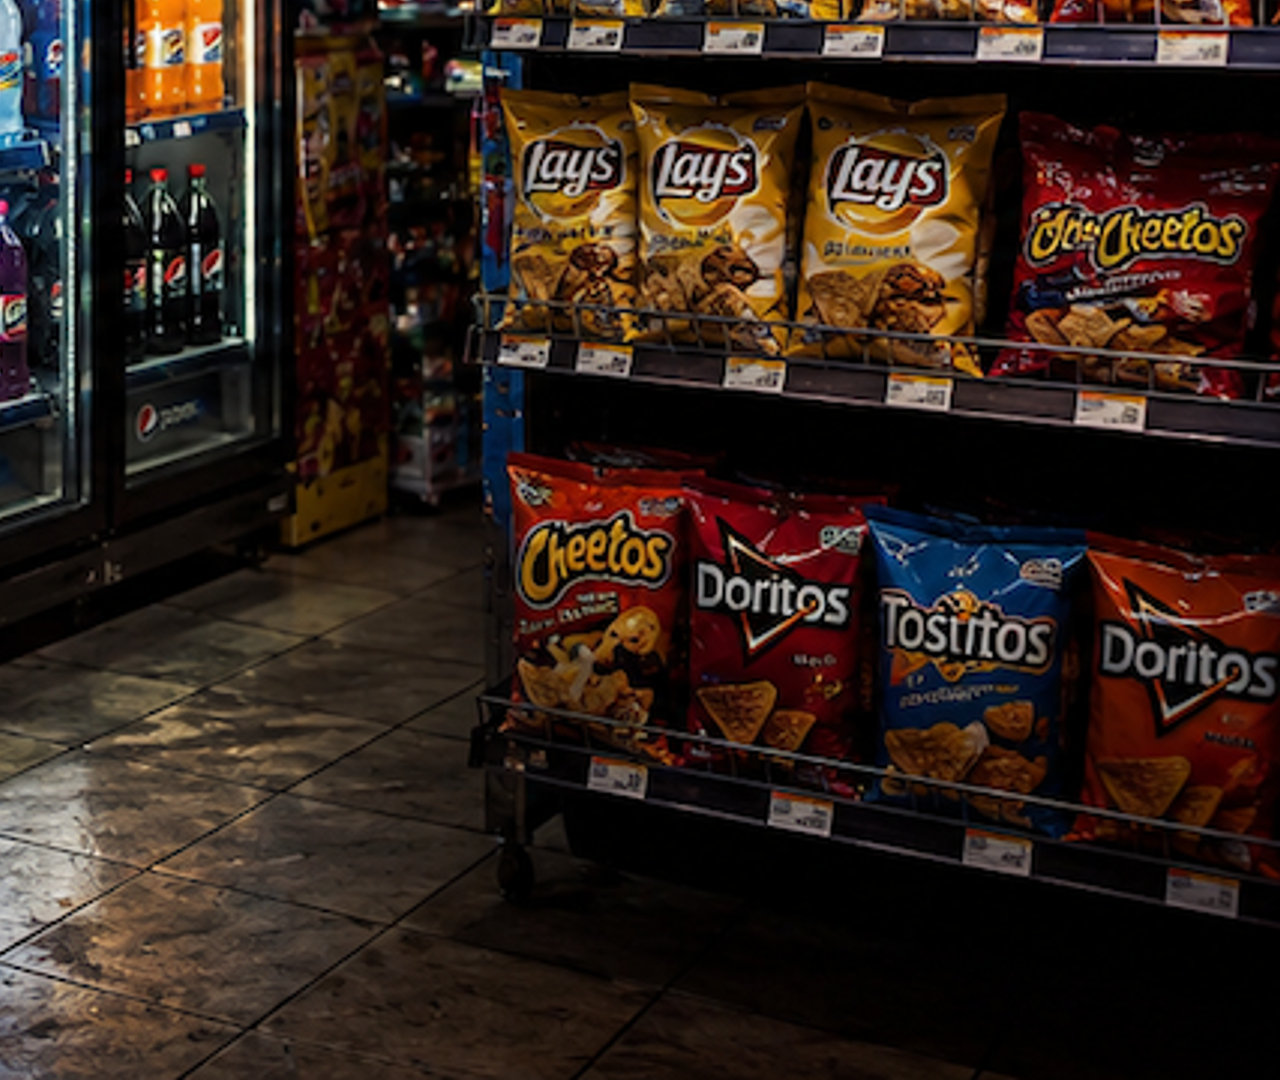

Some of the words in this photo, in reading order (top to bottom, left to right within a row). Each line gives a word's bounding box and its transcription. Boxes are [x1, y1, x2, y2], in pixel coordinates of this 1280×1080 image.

[520, 518, 671, 601] Cheetos
[696, 562, 850, 624] Doritos
[1102, 622, 1278, 698] Doritos
